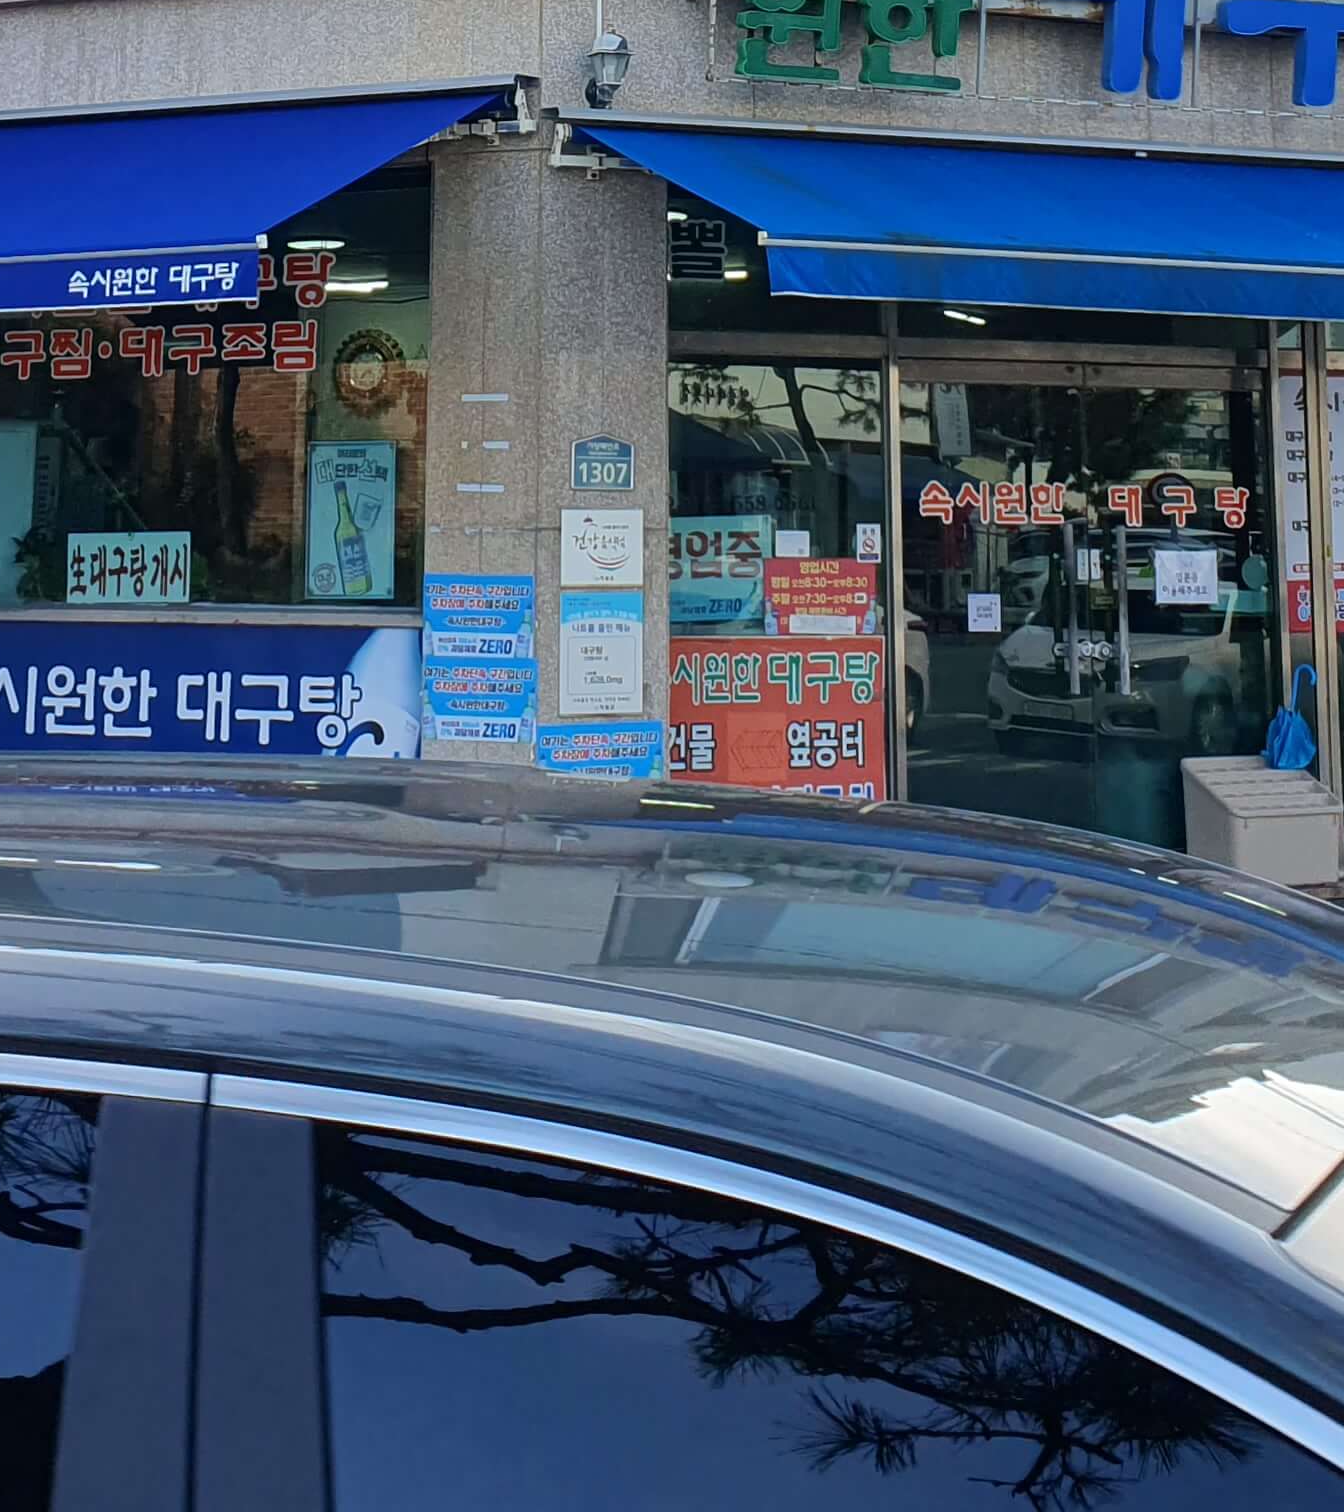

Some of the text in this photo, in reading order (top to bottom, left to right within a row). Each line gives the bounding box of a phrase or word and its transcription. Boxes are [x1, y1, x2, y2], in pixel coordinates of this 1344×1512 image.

[69, 262, 239, 299] 속시원한 대구탕
[579, 462, 628, 484] 1307
[920, 479, 1066, 525] 속시원한
[709, 599, 743, 614] ZERO
[478, 638, 513, 655] ZERO
[176, 670, 362, 749] 대구탕
[481, 722, 517, 739] ZERO
